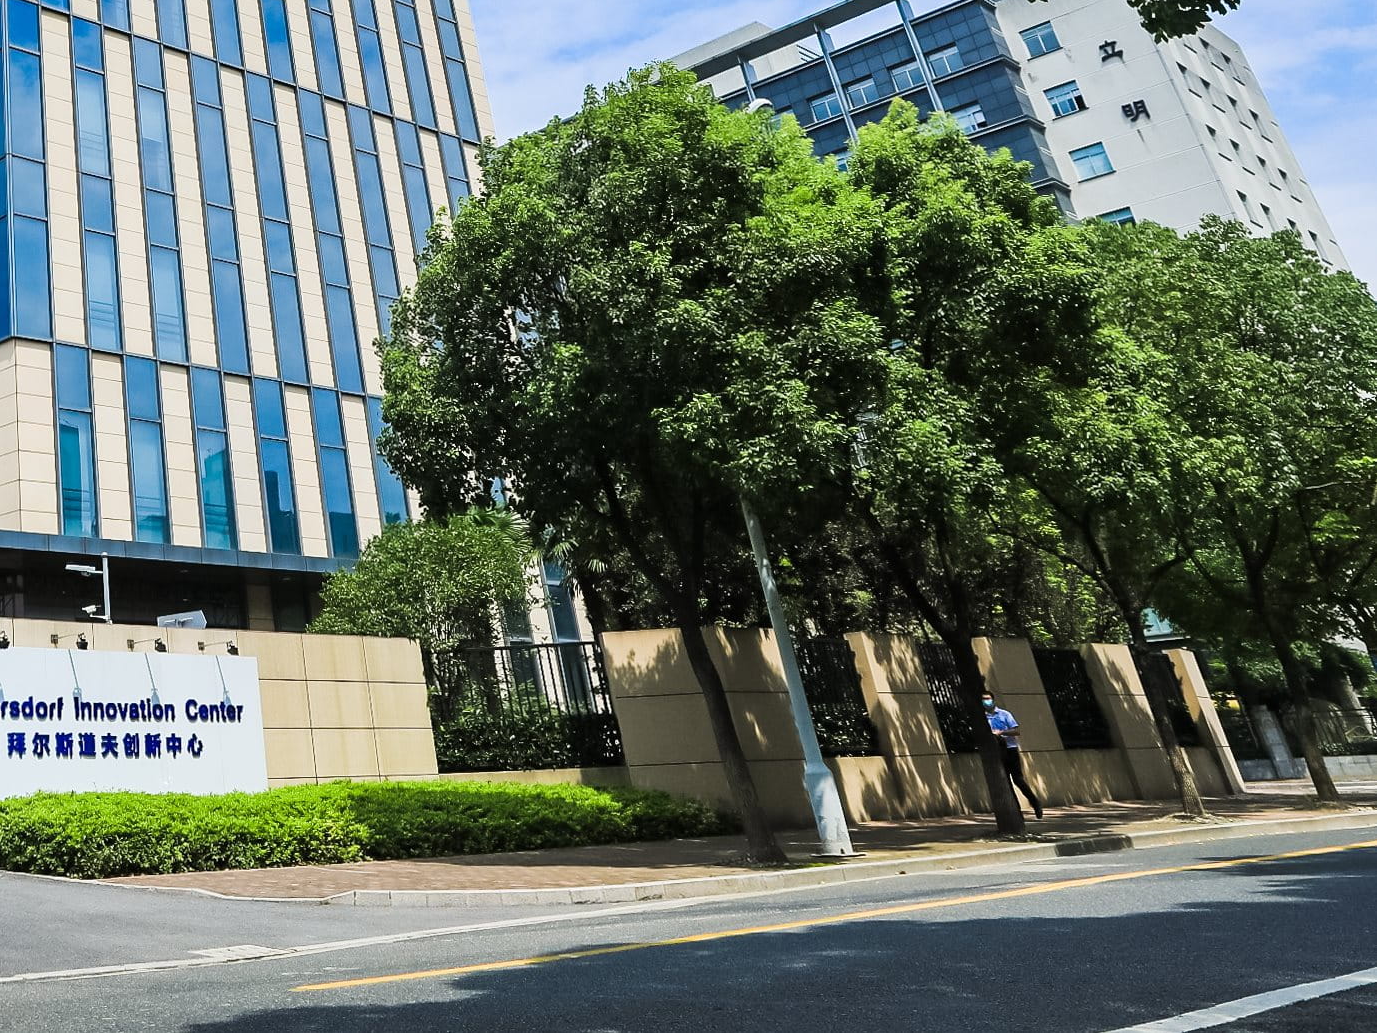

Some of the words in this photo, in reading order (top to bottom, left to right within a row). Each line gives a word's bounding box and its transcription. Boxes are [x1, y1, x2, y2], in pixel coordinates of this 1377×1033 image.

[1099, 40, 1151, 122] 立明
[74, 696, 175, 722] Innovation
[185, 699, 244, 723] Center
[7, 732, 203, 760] 拜尔斯道夫创新中心
